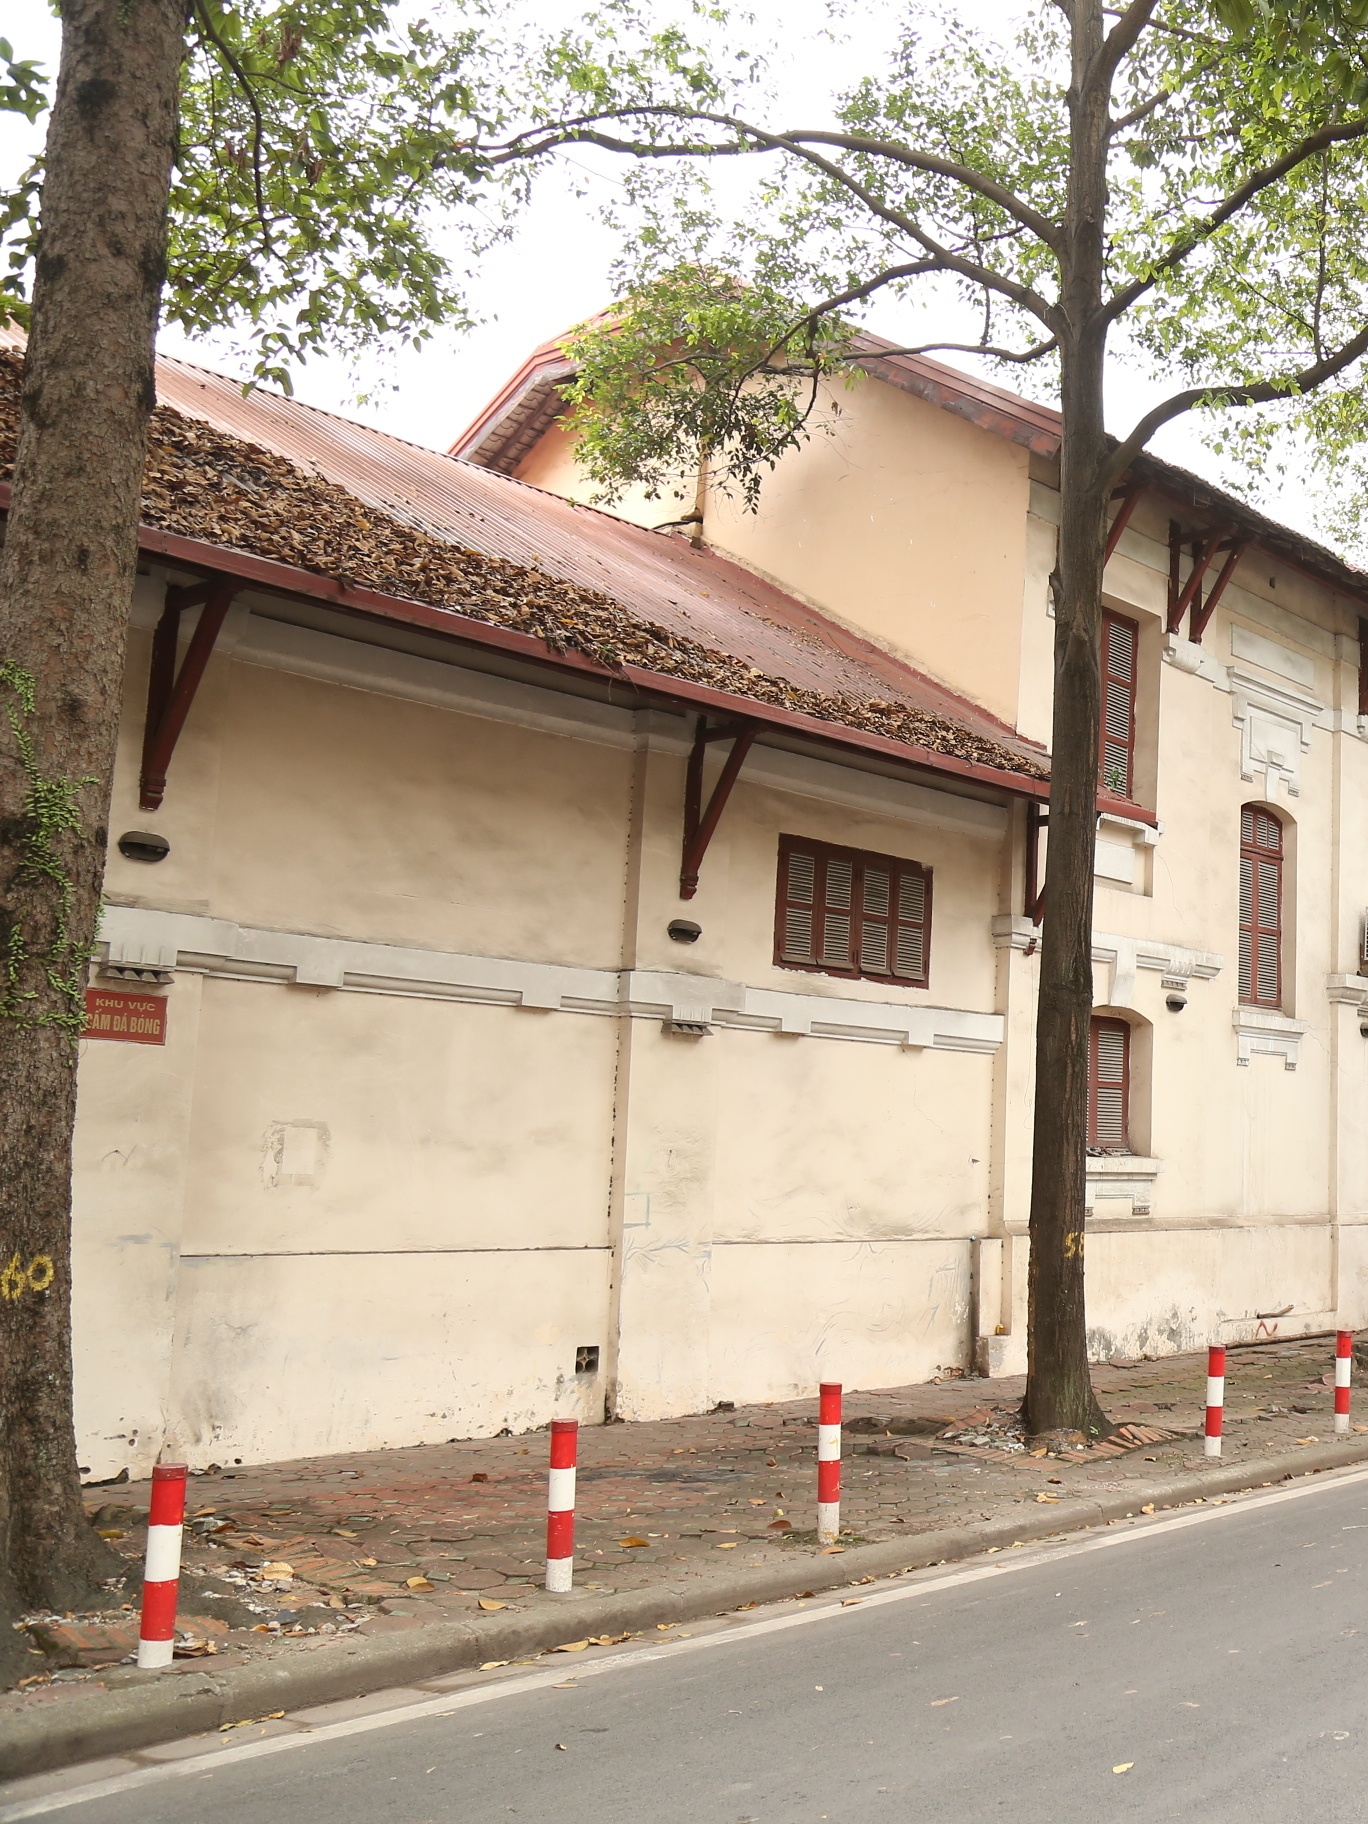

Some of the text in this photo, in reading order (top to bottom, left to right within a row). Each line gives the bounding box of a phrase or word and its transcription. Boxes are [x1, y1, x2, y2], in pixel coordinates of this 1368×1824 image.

[95, 998, 156, 1012] KHU VỰC
[85, 1008, 161, 1035] CẤM ĐÁ BÓNG
[1, 1251, 55, 1300] 60
